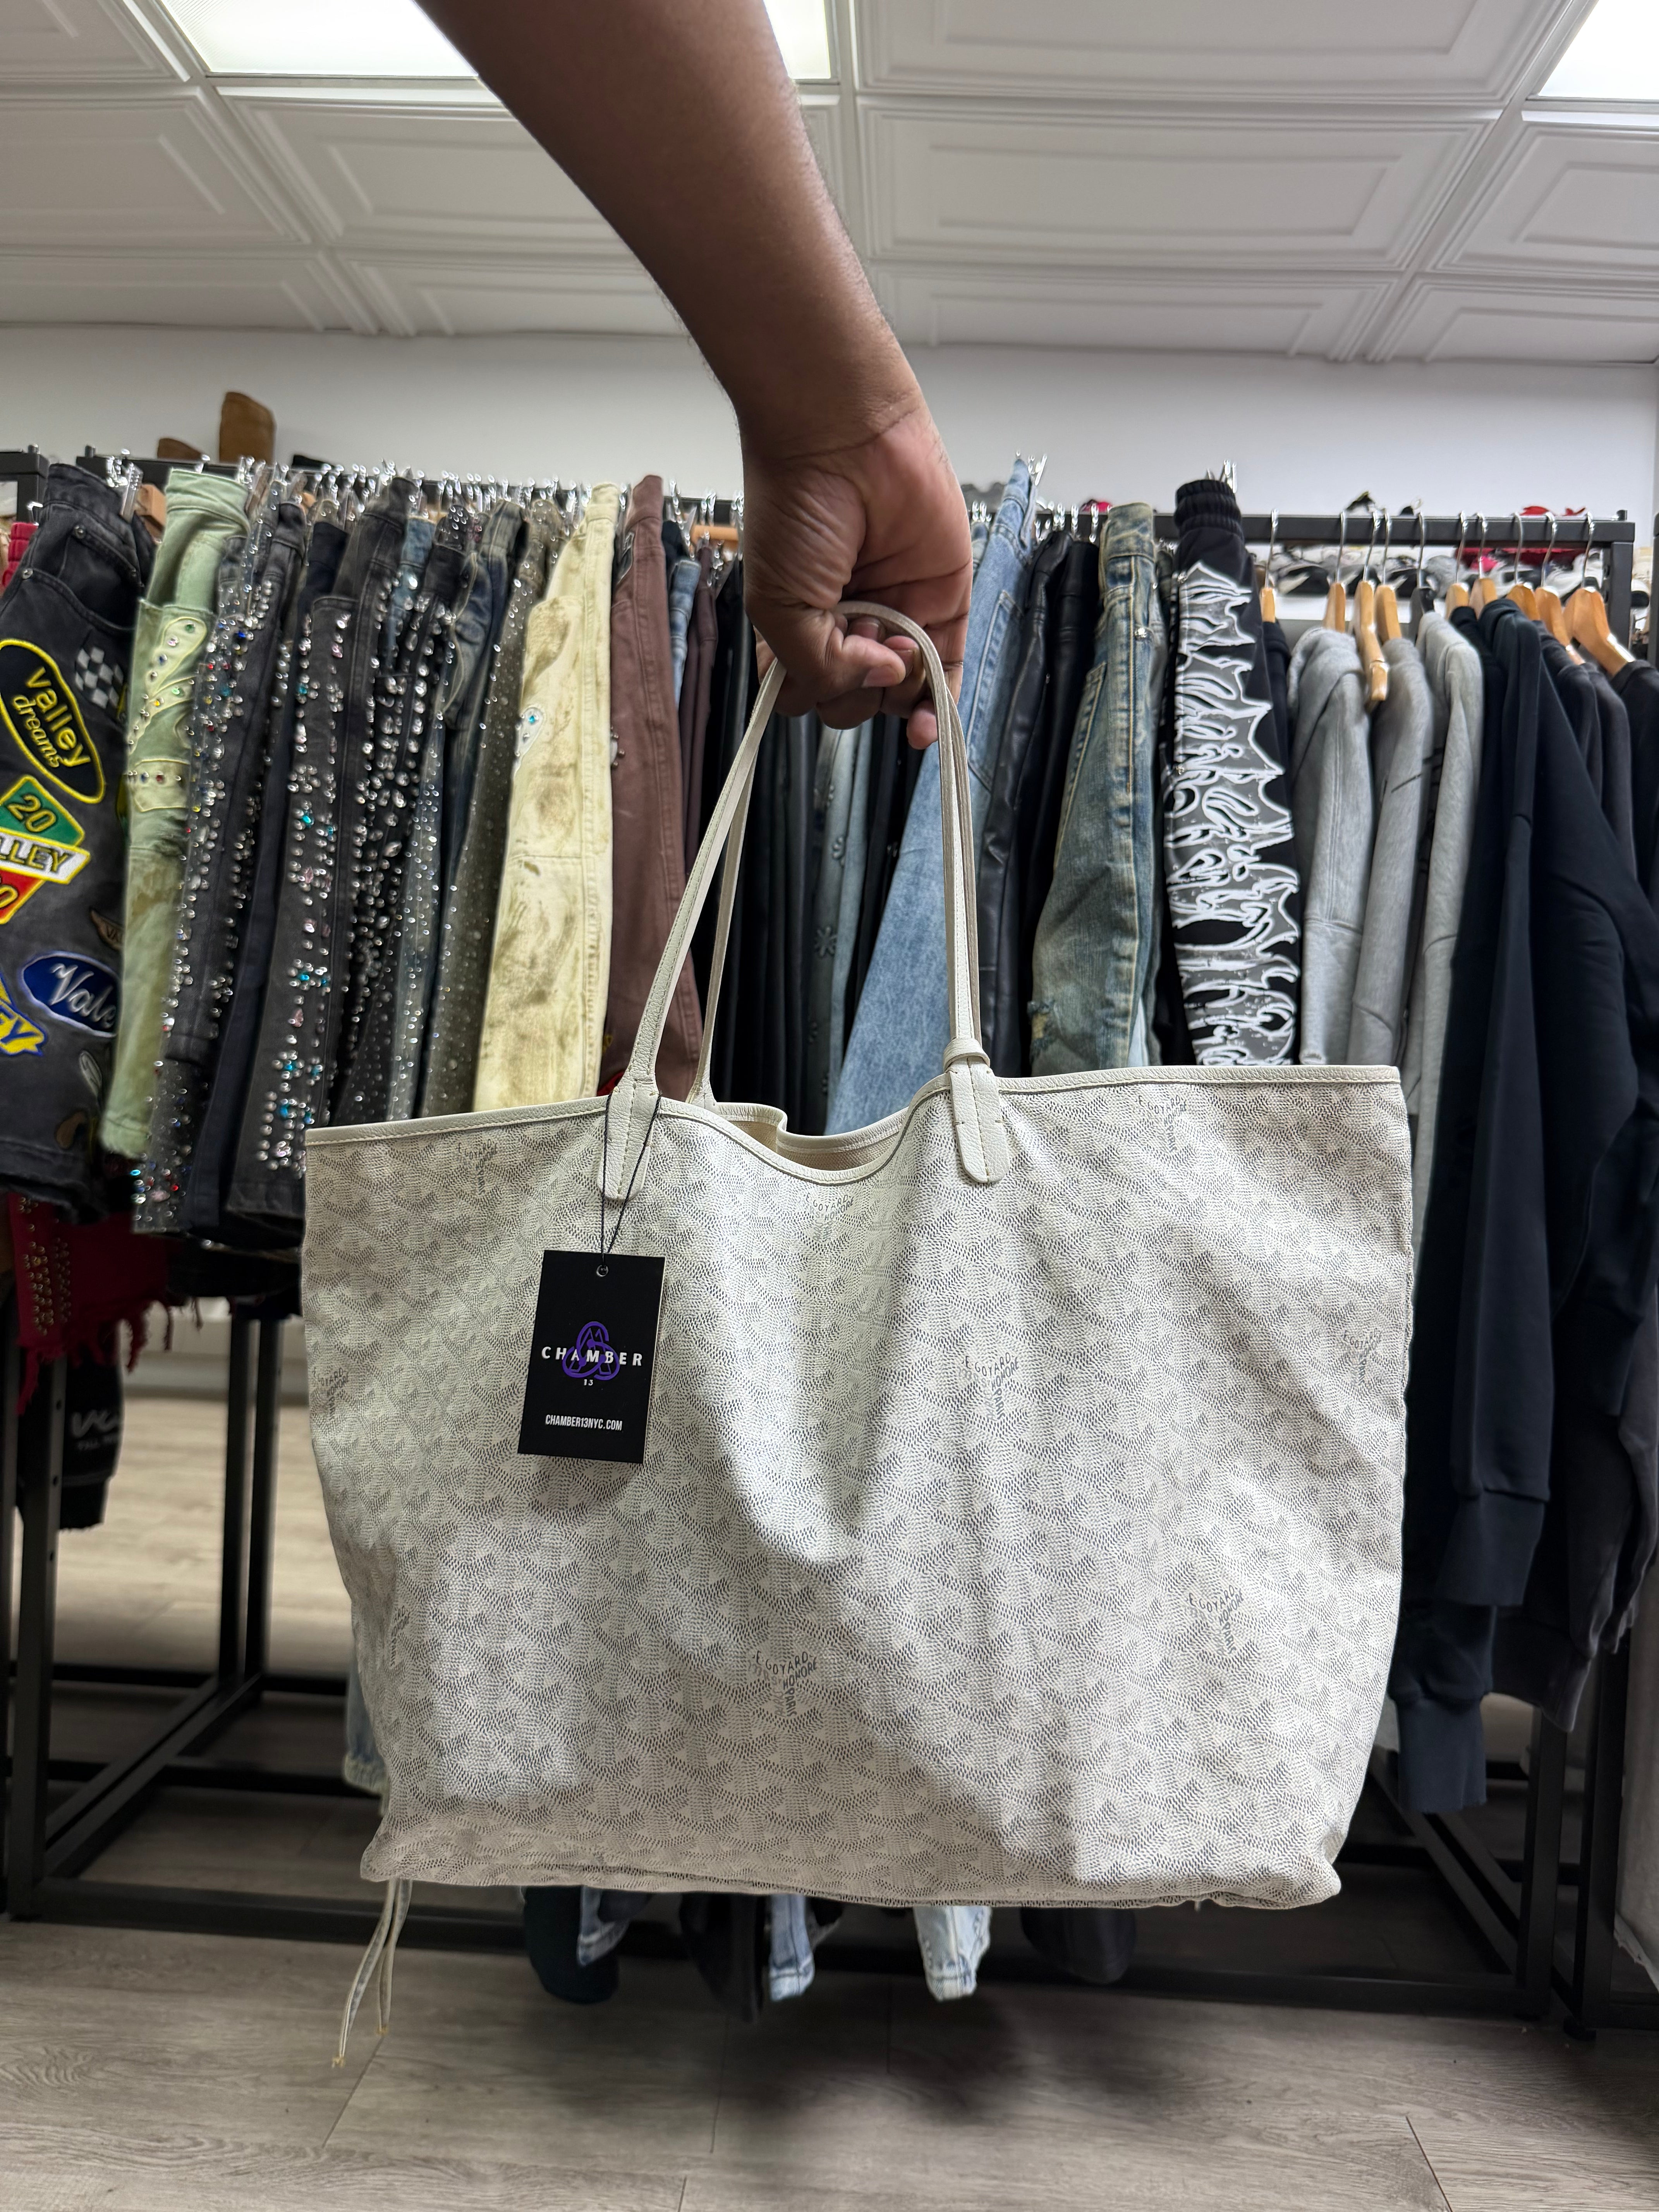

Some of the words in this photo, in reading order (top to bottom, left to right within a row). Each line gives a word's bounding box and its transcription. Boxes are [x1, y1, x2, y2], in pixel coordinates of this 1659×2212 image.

[26, 666, 91, 767] valley
[12, 695, 60, 768] dreams
[7, 794, 56, 832] 20
[813, 1195, 848, 1212] GOYARD
[542, 1346, 642, 1366] CHAMBER
[975, 1352, 1011, 1377] GOYARD
[991, 1357, 1019, 1391] HONORE
[993, 1388, 1006, 1420] PARIS
[546, 1415, 622, 1431] CHAMBER13NYC.COM
[1199, 1585, 1235, 1613] GOYARD
[766, 1651, 808, 1675] GOYARD
[783, 1657, 817, 1690] HONORE
[785, 1687, 797, 1716] PARIS
